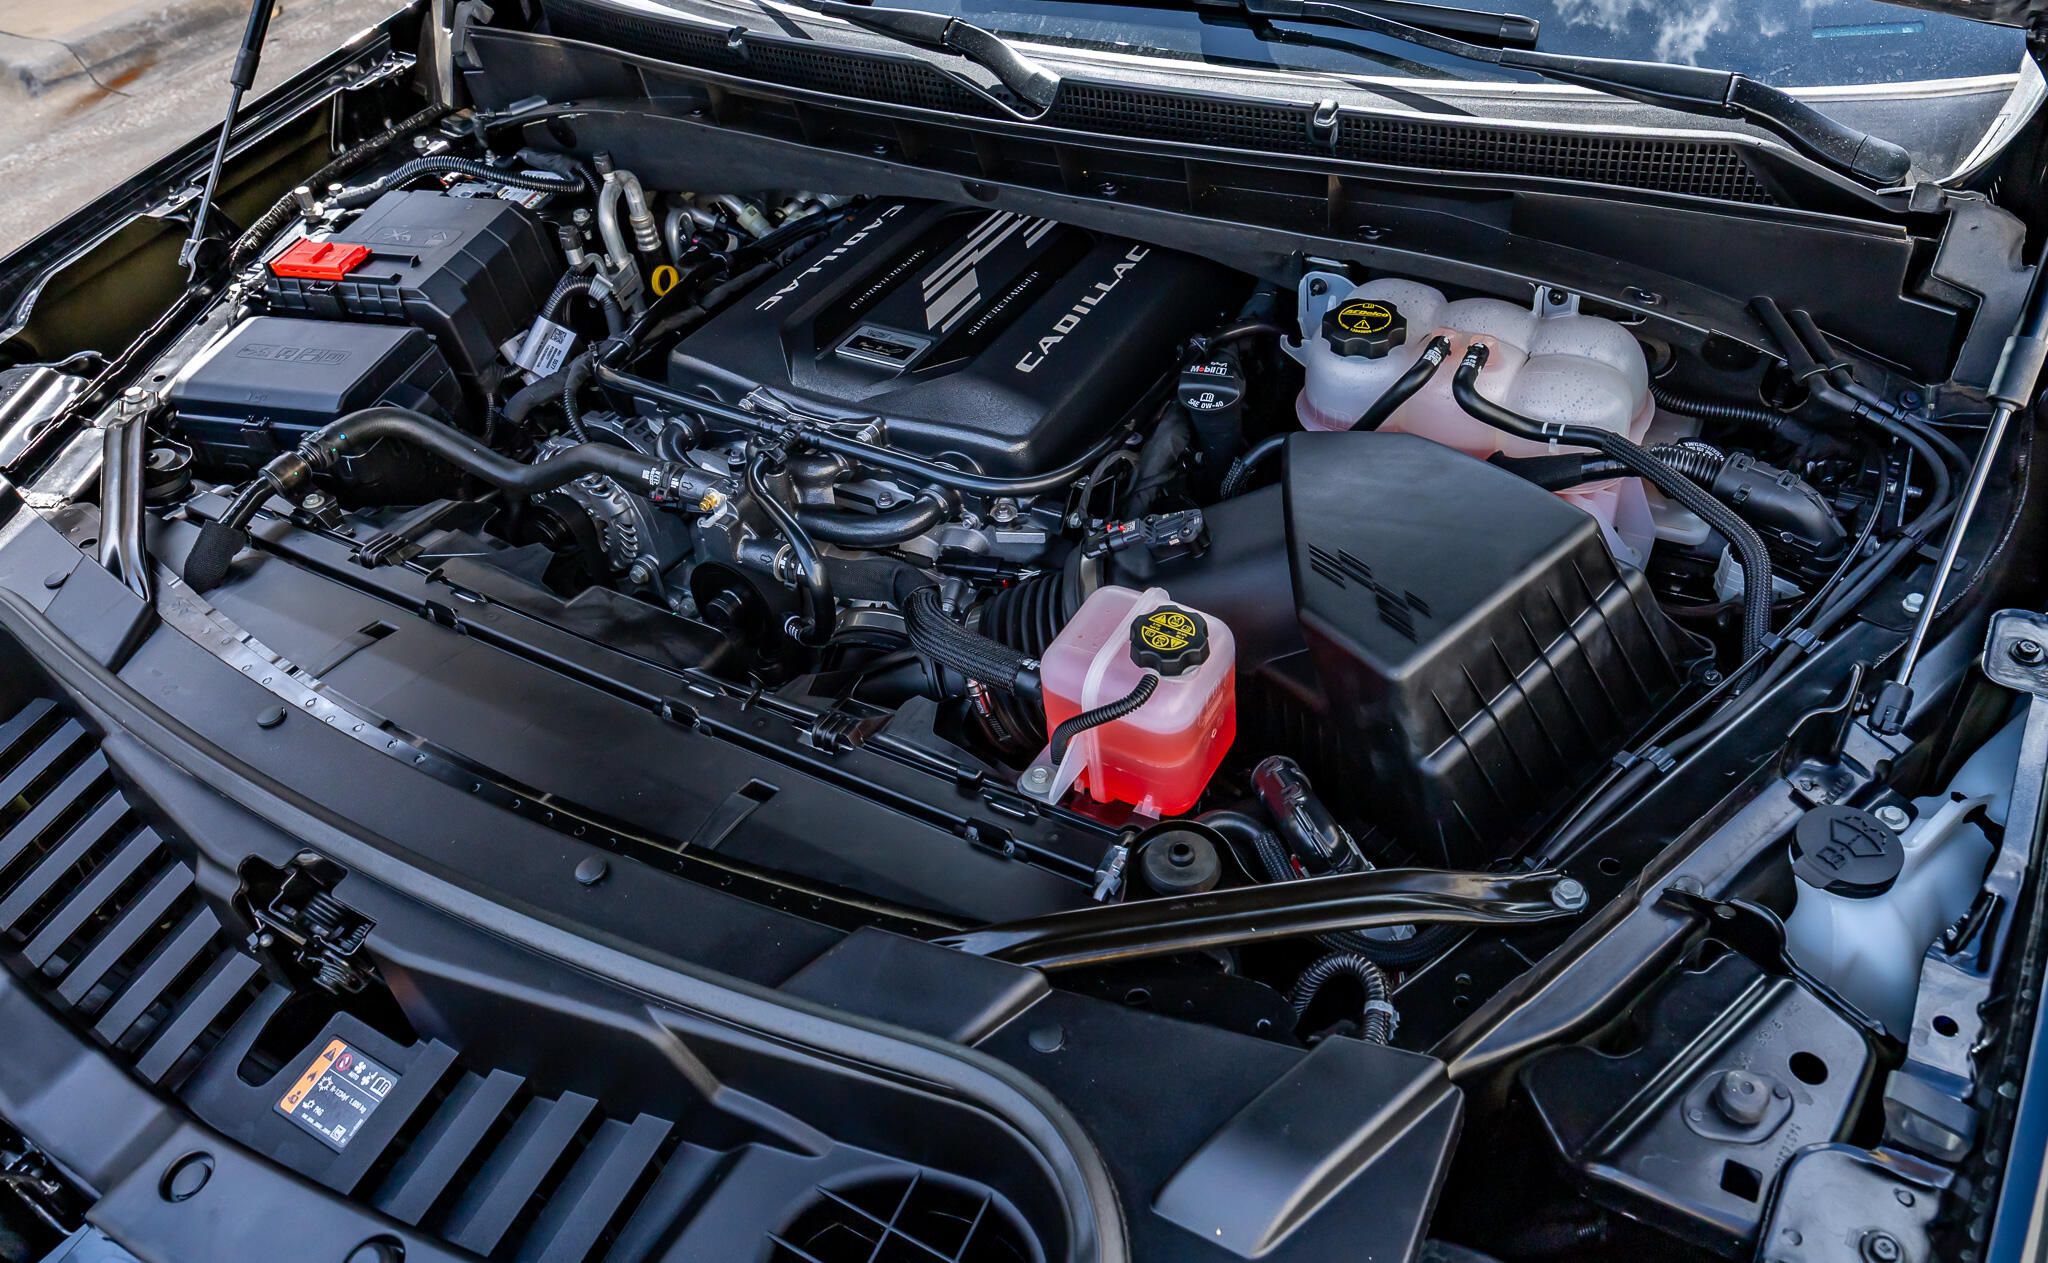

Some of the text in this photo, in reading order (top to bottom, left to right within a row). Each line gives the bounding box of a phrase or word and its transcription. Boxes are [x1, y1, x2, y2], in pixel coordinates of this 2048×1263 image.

[755, 204, 905, 311] CADILLAC
[967, 271, 1040, 336] SUPERCHARGED
[1015, 245, 1150, 373] CADILLAC
[1187, 398, 1201, 408] SAE
